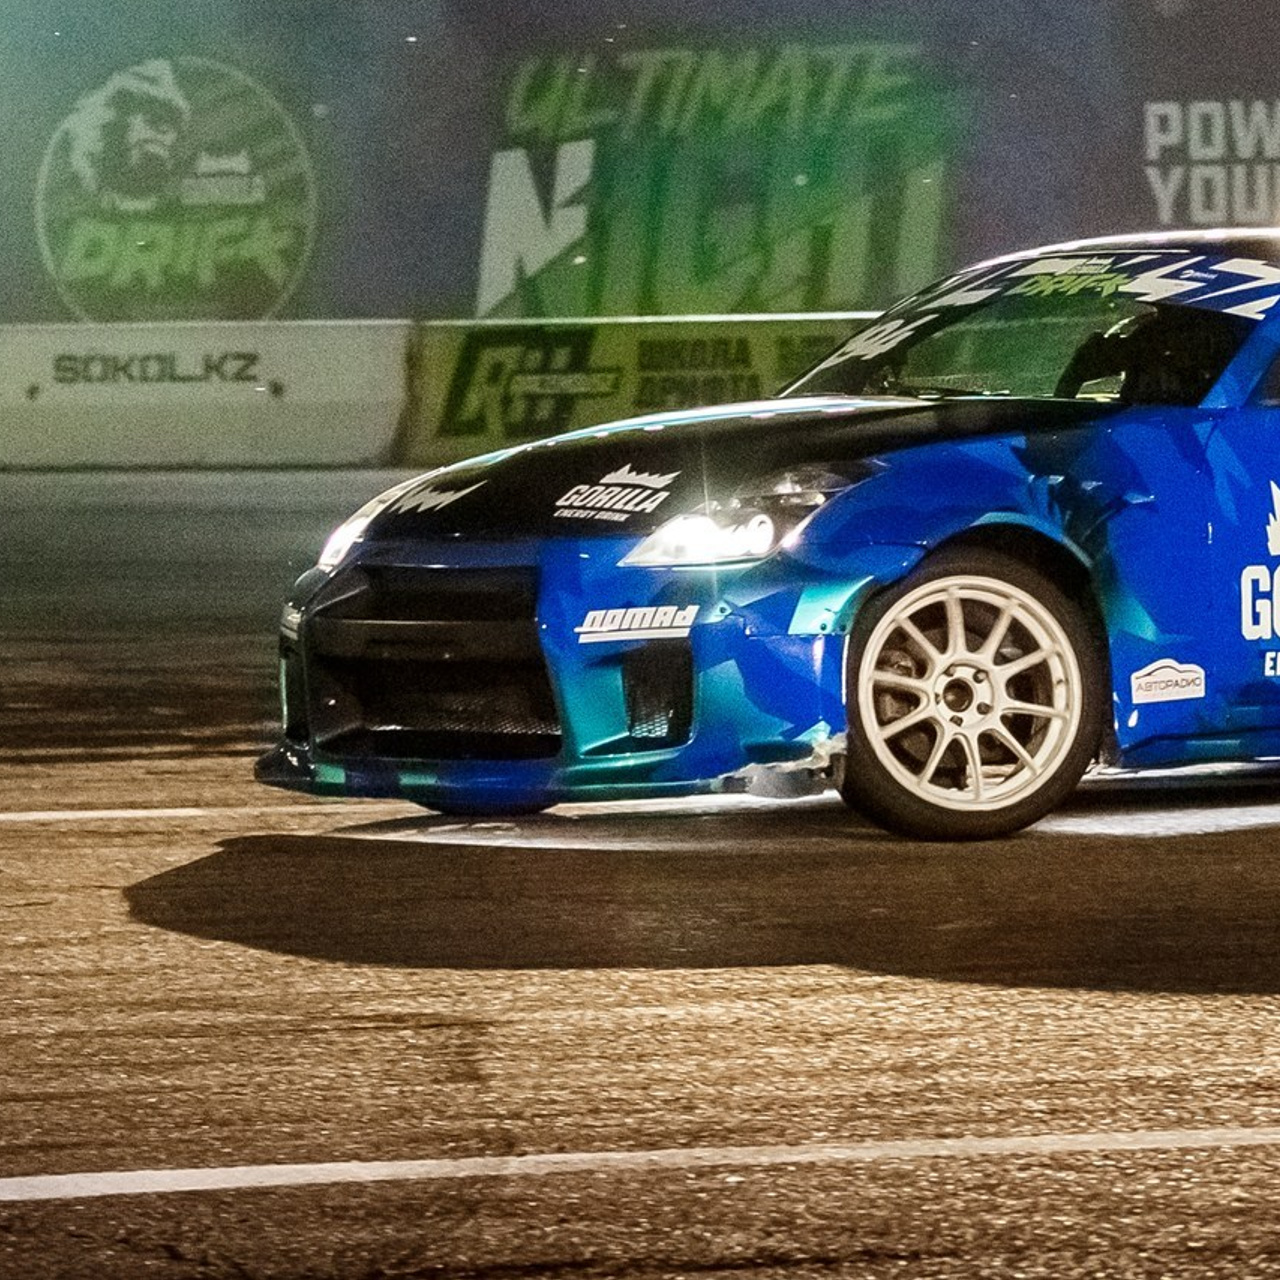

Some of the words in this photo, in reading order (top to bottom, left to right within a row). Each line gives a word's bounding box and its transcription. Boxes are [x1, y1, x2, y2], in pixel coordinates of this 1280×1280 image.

[505, 42, 921, 138] ULTIMATE
[60, 216, 294, 287] DRIFT
[475, 128, 946, 316] NIGHT
[555, 484, 671, 513] GORILLA
[1136, 677, 1202, 692] АВТОРАДИО
